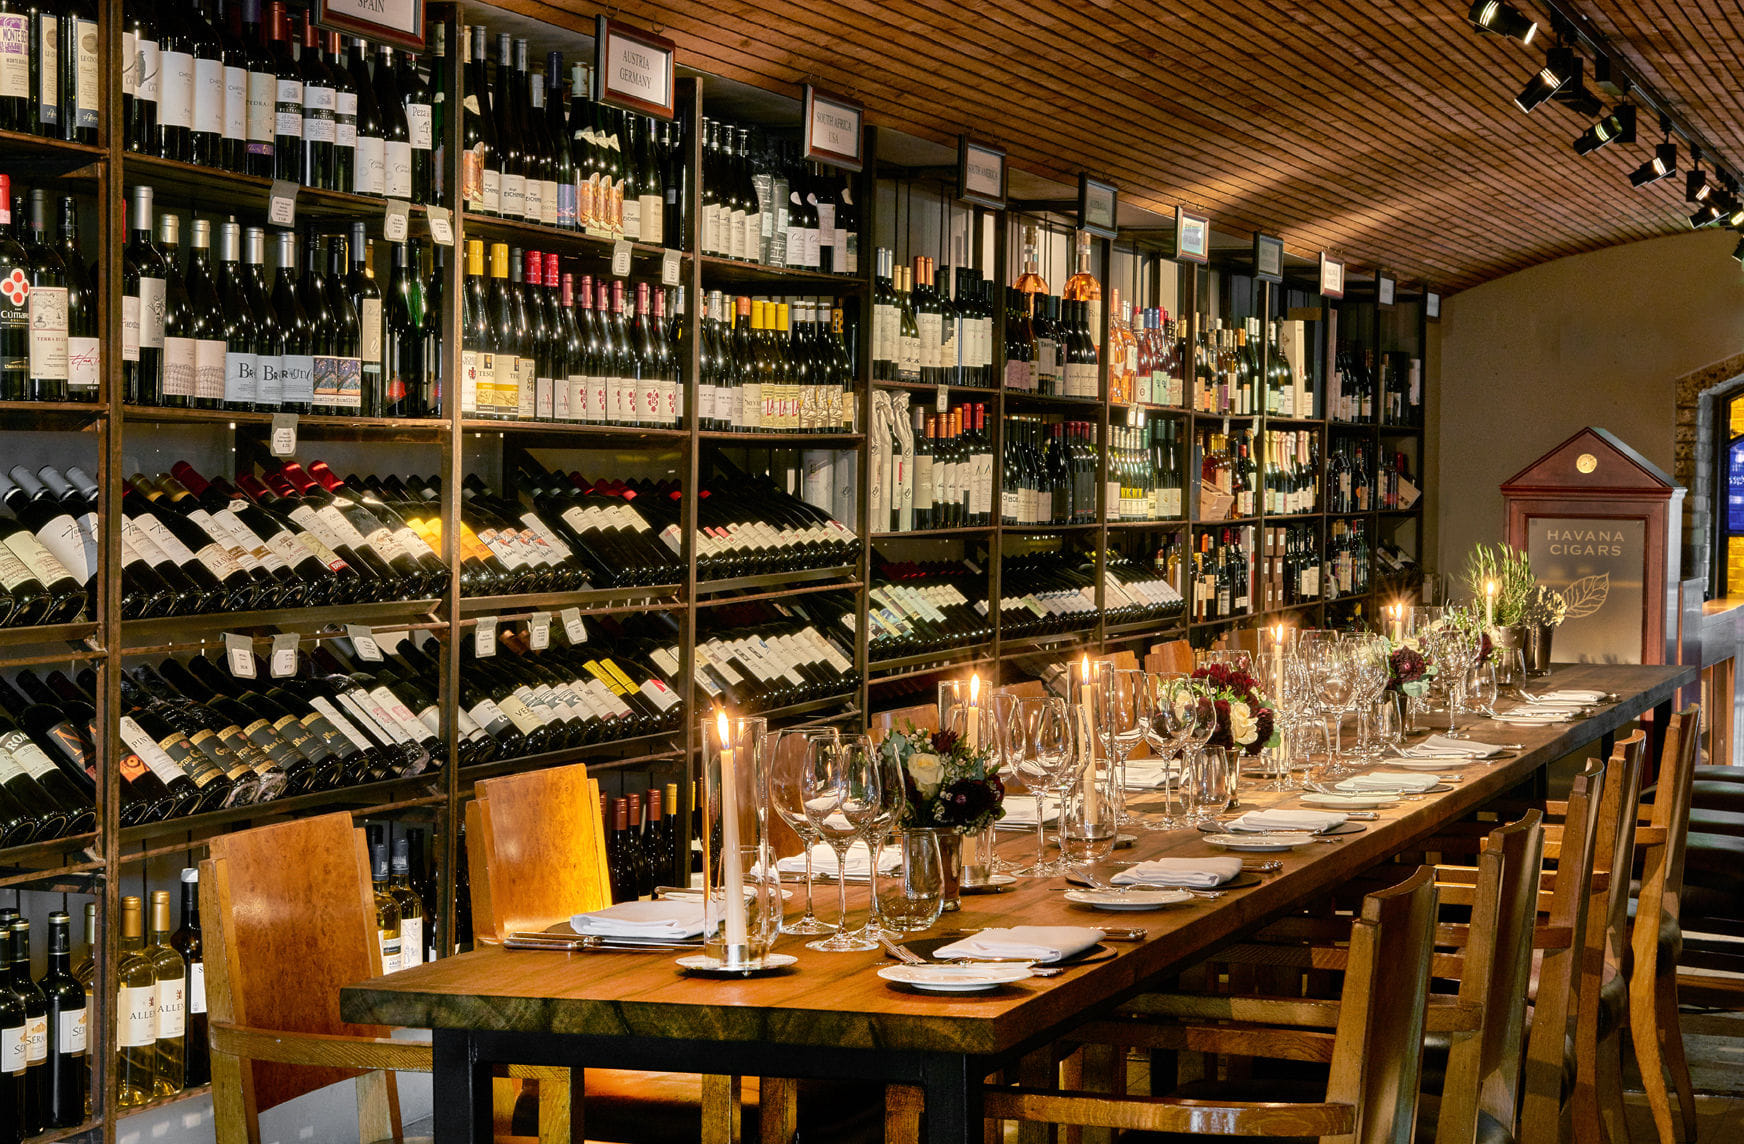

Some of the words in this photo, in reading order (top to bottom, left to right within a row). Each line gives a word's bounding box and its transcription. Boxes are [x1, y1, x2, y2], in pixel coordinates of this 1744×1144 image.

[357, 0, 385, 13] SPAIN
[622, 50, 650, 71] AUSTRIA
[619, 67, 652, 90] GERMANY
[817, 112, 833, 126] SOUTH
[834, 117, 852, 132] AFRICA
[828, 131, 839, 144] USA
[1547, 530, 1624, 542] HAVANA
[1550, 544, 1622, 556] CIGARS
